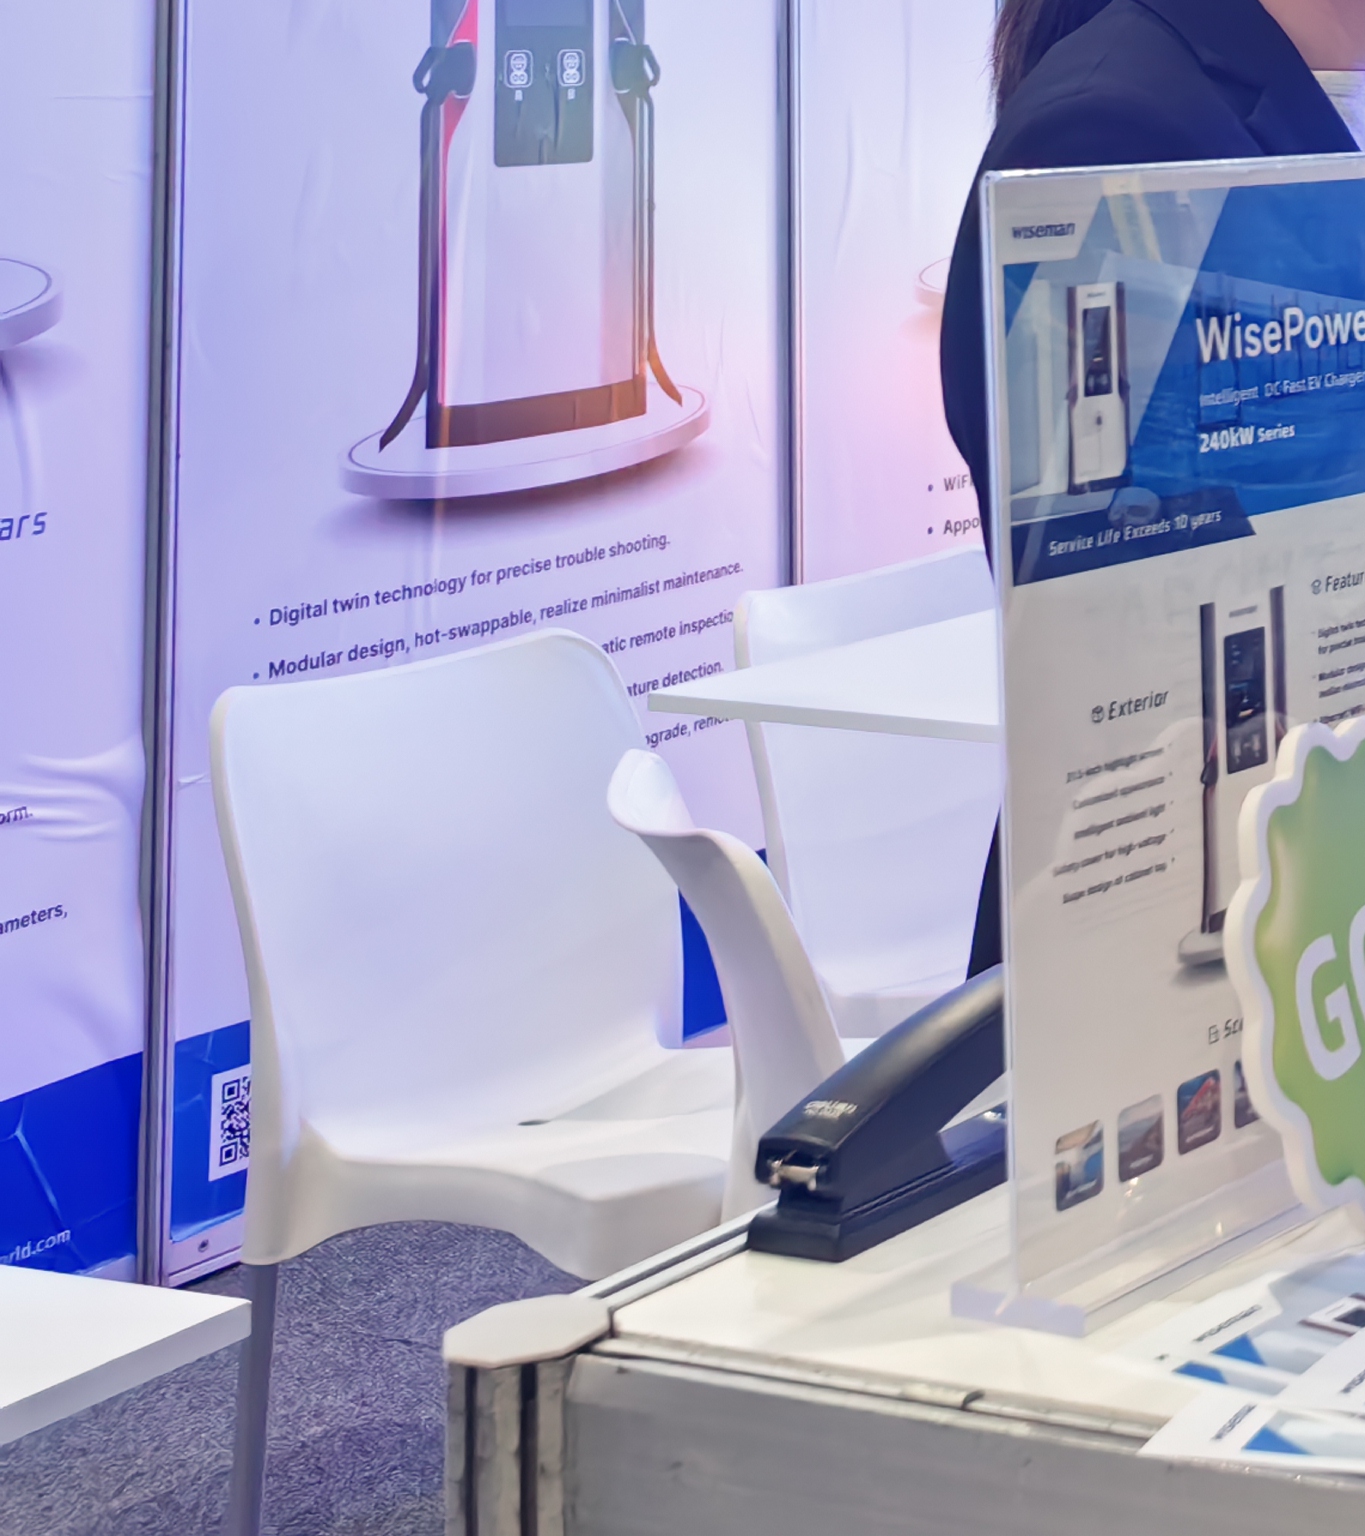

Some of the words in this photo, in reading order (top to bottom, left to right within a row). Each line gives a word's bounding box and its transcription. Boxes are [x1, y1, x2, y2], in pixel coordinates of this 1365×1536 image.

[1199, 425, 1254, 453] 240kW
[1258, 423, 1296, 443] Series
[943, 517, 980, 537] Appo
[1049, 535, 1094, 556] Service
[270, 599, 327, 626] Digital
[333, 593, 370, 614] twin
[374, 575, 467, 605] technology
[471, 569, 493, 586] for
[496, 558, 551, 584] precise
[555, 547, 605, 568] trouble
[609, 533, 671, 557] shooting.
[268, 651, 343, 679] Modular
[348, 638, 411, 662] design,
[415, 608, 537, 648] hot-swappable,
[540, 597, 587, 620] realize
[591, 580, 660, 608] minimalist
[663, 562, 743, 591] maintenance.
[630, 626, 676, 648] remote
[679, 610, 734, 635] inspectio
[662, 661, 724, 688] detection.
[1108, 690, 1169, 720] Exterior
